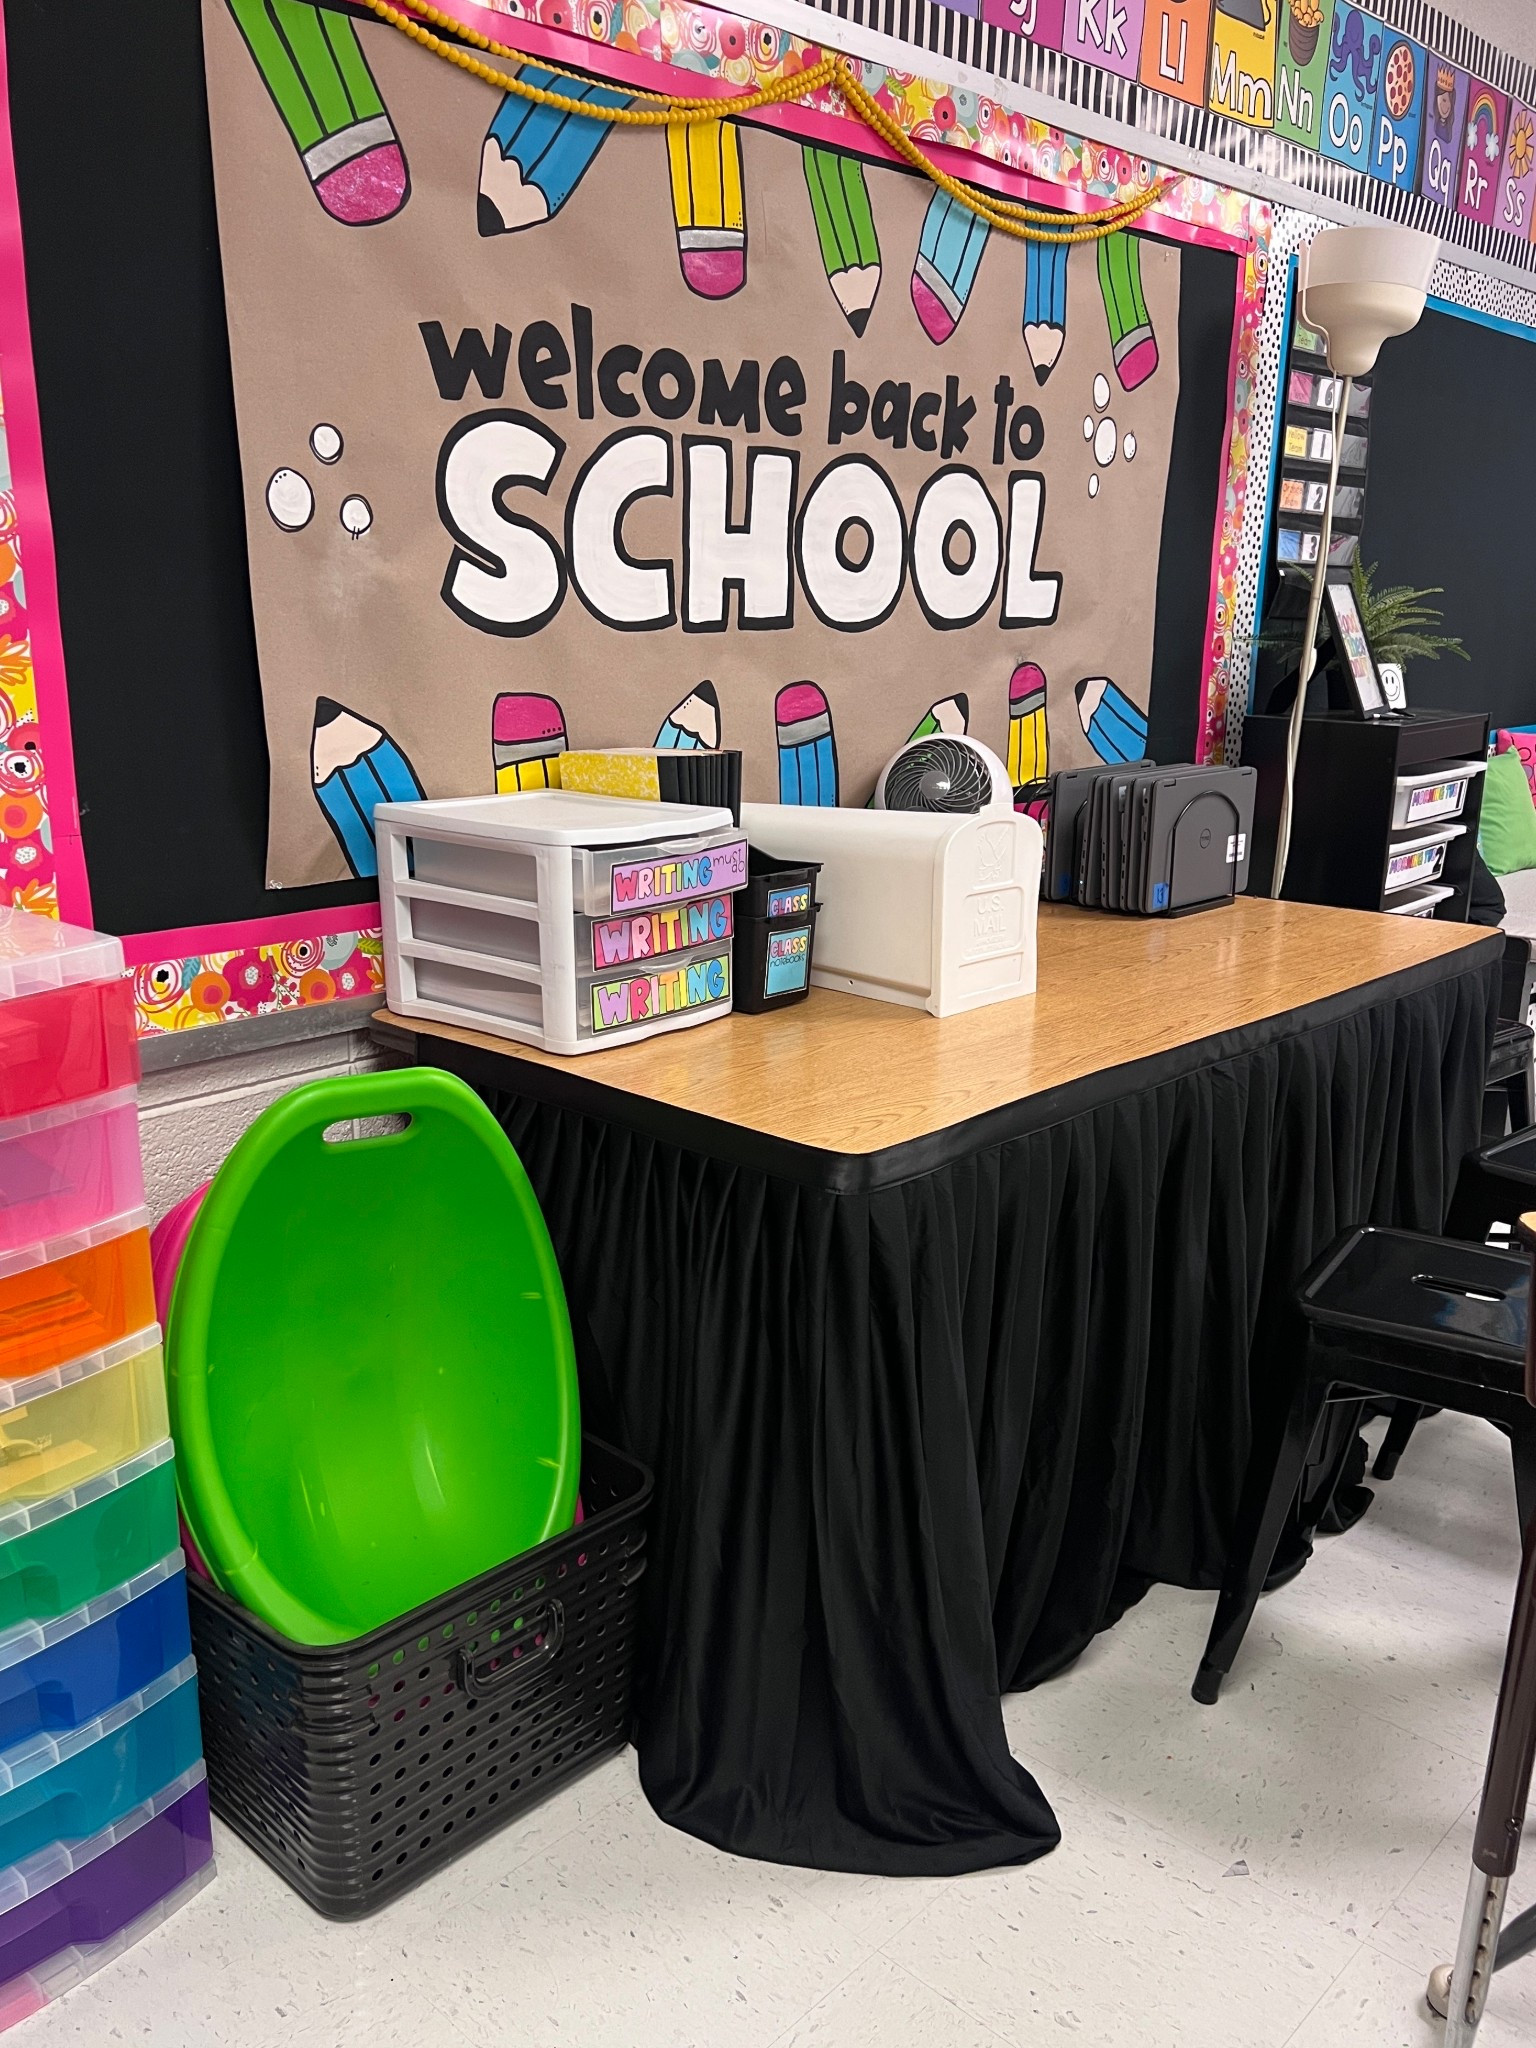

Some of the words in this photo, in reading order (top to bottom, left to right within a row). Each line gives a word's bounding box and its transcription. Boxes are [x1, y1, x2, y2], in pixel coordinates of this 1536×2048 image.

[1076, 0, 1128, 59] Kk
[1159, 11, 1188, 84] Ll
[1210, 42, 1274, 121] Mm
[1276, 64, 1314, 134] Nn
[1328, 92, 1363, 155] Oo
[1377, 115, 1408, 185] Pp
[1428, 138, 1451, 207] Qq
[1463, 157, 1488, 210] Rr
[1503, 177, 1525, 227] Ss
[828, 350, 977, 460] back
[993, 375, 1045, 465] to
[435, 408, 1063, 638] SCHOOL
[1313, 485, 1324, 510] 2
[1308, 535, 1318, 559] 3
[615, 856, 713, 902] WRITING
[712, 848, 743, 868] must
[1432, 845, 1445, 874] 2
[600, 898, 727, 965] WRITING
[770, 893, 809, 916] CLASS
[973, 913, 1007, 938] MAIL
[976, 893, 1005, 916] U.S.
[769, 935, 808, 959] CLASS
[769, 953, 806, 968] notebooks
[597, 959, 725, 1026] WRITING
